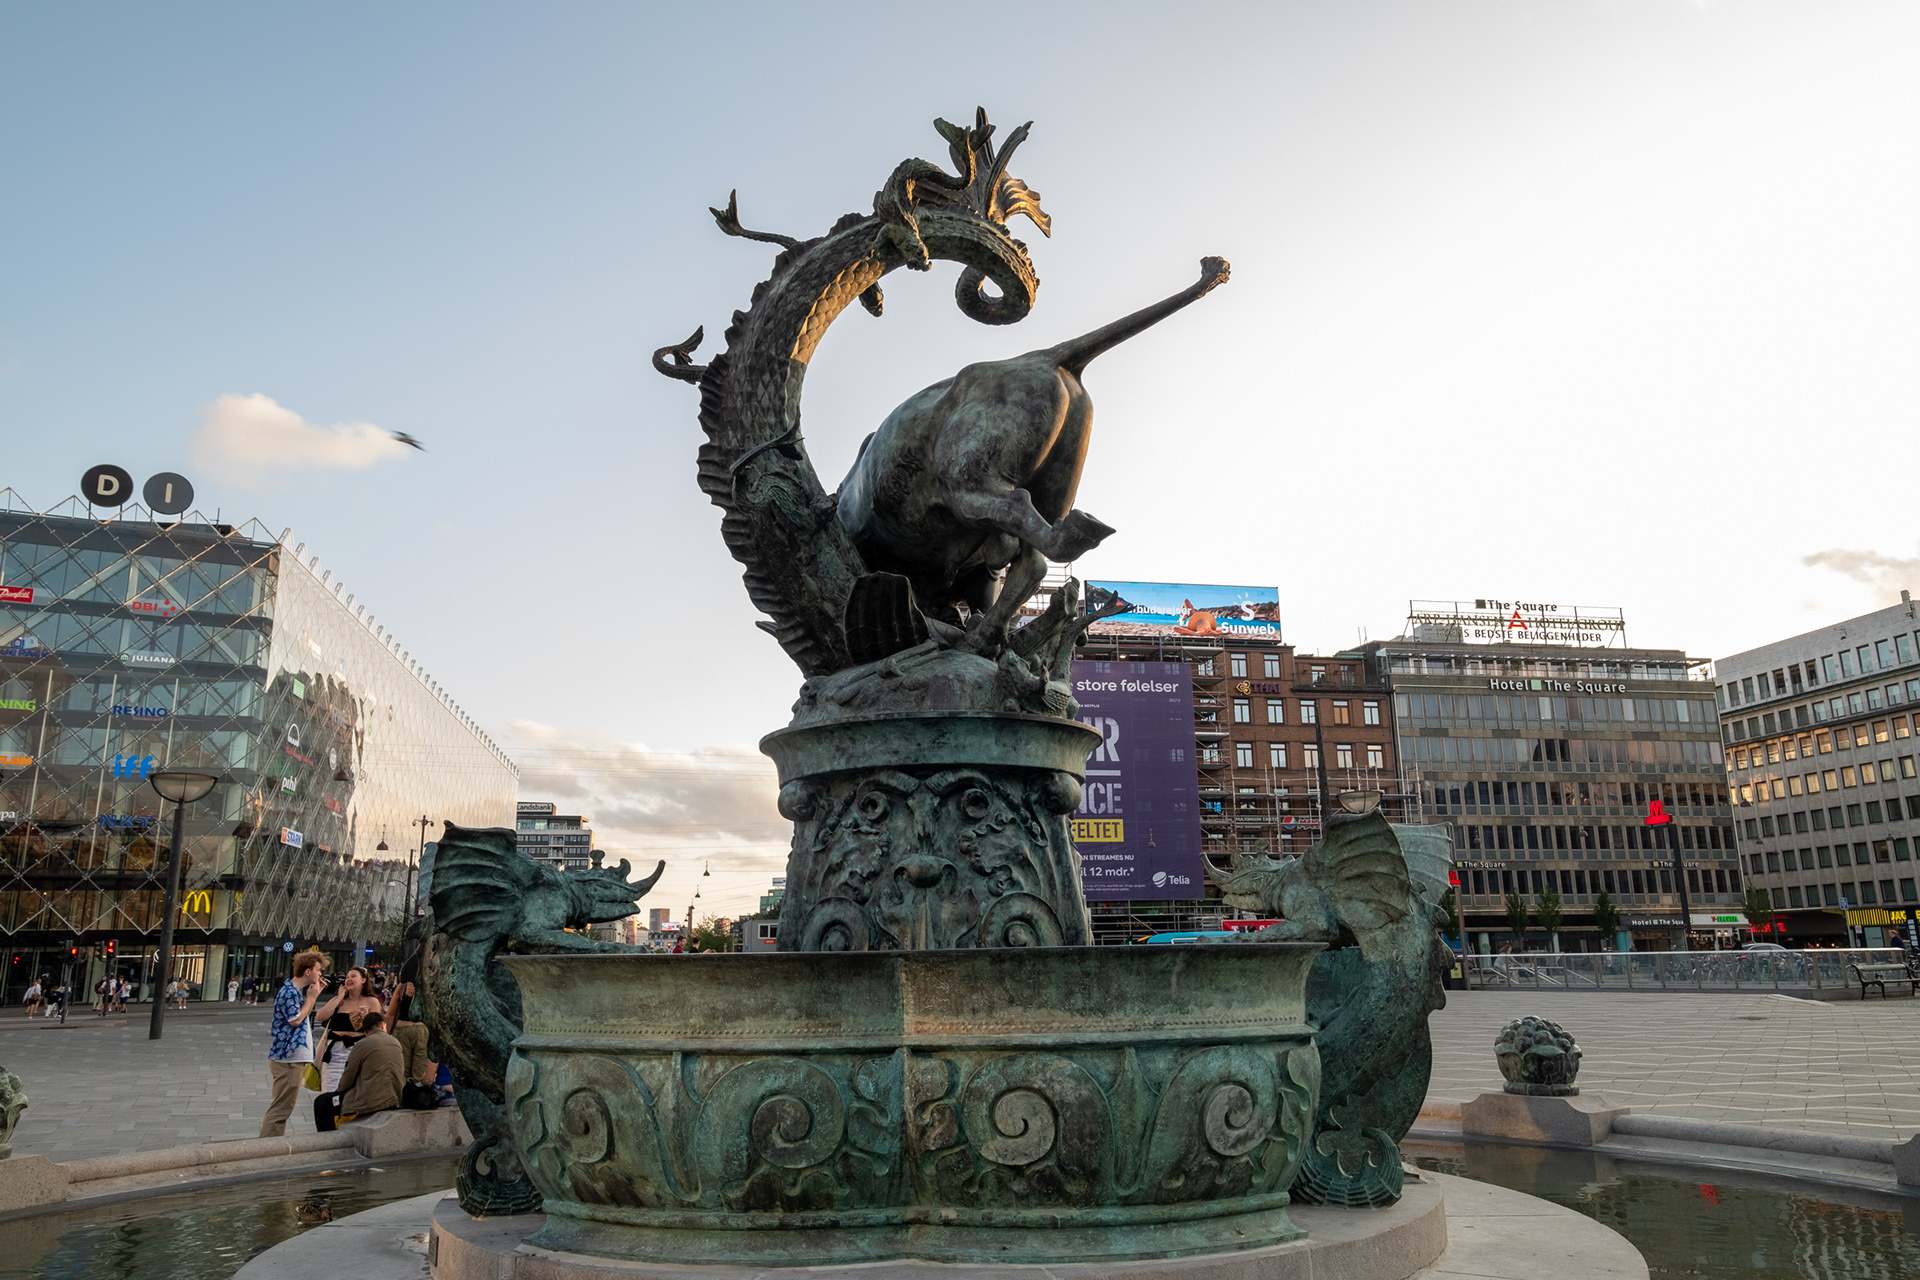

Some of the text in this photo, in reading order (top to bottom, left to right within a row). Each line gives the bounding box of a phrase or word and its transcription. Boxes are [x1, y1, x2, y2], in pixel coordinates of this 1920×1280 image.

[97, 474, 173, 504] D I
[131, 601, 158, 611] DBI
[1487, 599, 1558, 613] The Square
[1221, 622, 1276, 635] Sunweb
[1474, 629, 1514, 639] BEDSTE
[1517, 630, 1602, 642] BELIGGENHEDER
[131, 655, 177, 665] JULIANA
[1076, 679, 1179, 692] store følelser
[1251, 683, 1280, 693] THAI
[1490, 679, 1626, 694] Hotel The Square
[113, 706, 168, 718] RESINO
[113, 754, 153, 778] iff
[100, 814, 153, 828] NKT
[1480, 861, 1506, 869] Square
[1089, 867, 1103, 877] 12
[1168, 875, 1190, 885] Telia
